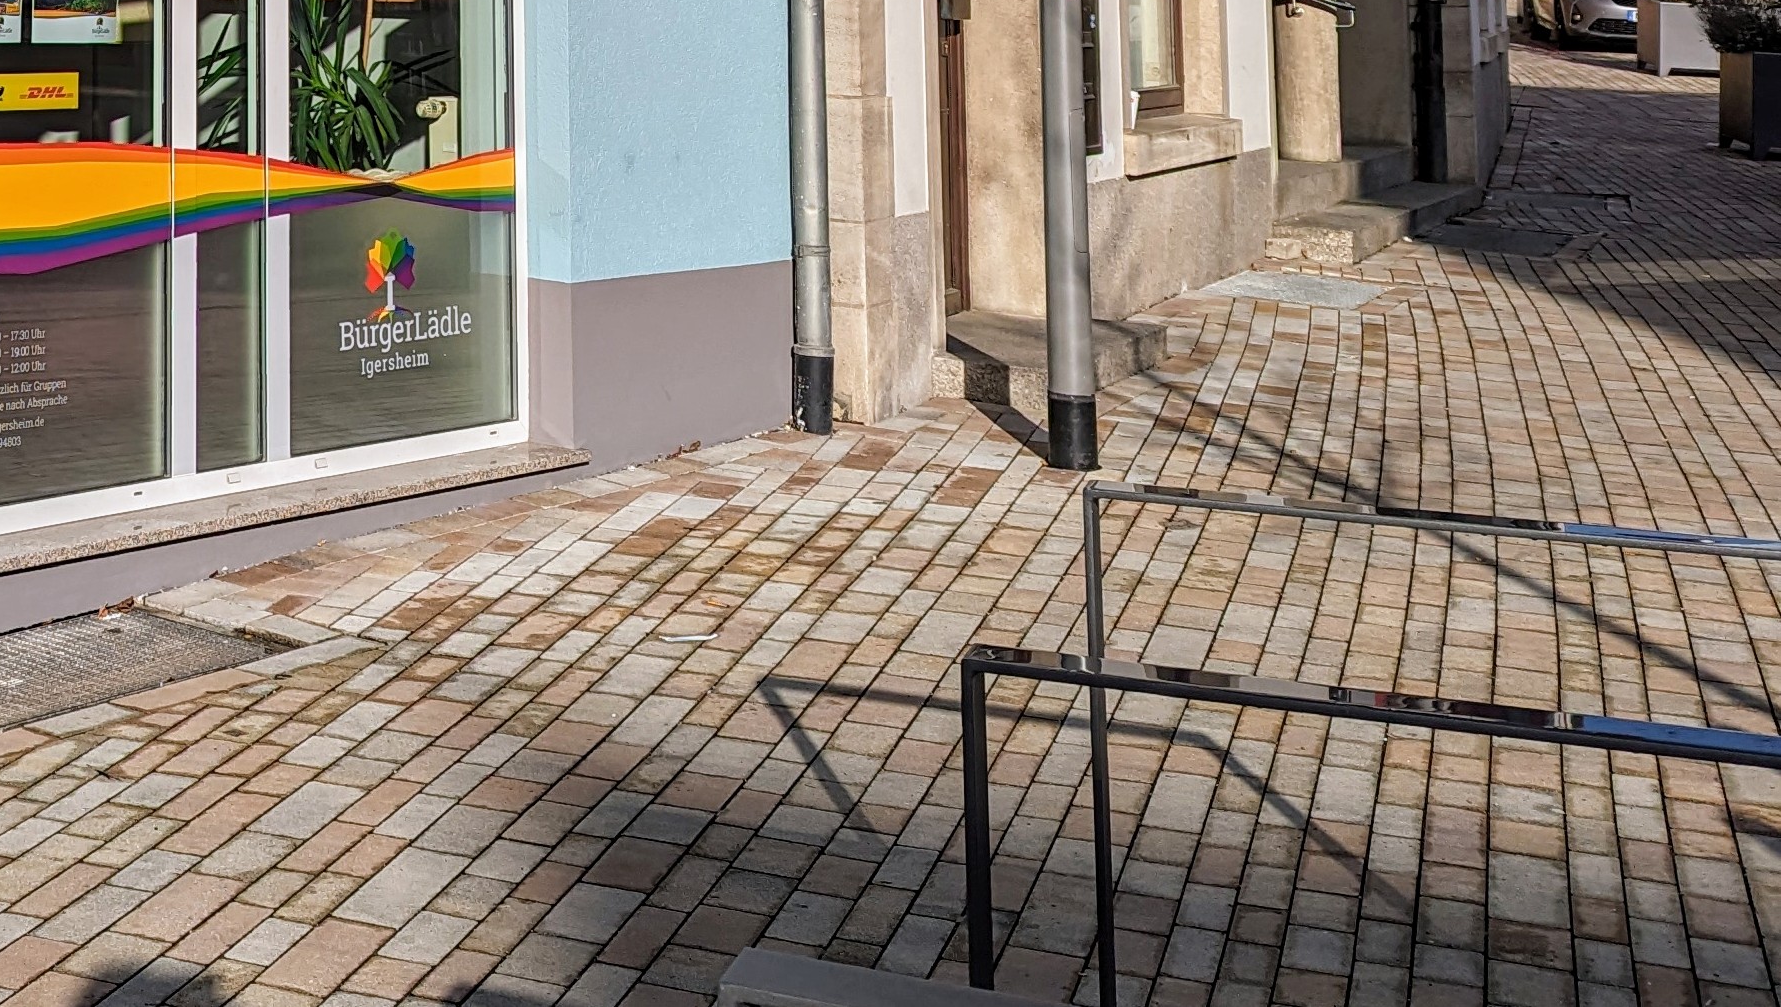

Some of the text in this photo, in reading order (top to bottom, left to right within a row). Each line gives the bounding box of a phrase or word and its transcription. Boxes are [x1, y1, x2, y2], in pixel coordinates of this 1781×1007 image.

[27, 85, 68, 99] DHL
[30, 328, 46, 340] Uhr
[338, 305, 472, 353] BürgerLädle
[31, 345, 46, 356] Uhr
[31, 361, 46, 373] Uhr
[360, 350, 429, 379] Igersheim
[21, 381, 32, 393] für
[34, 379, 67, 393] Gruppen
[6, 397, 26, 411] nach
[27, 394, 68, 408] Absprache
